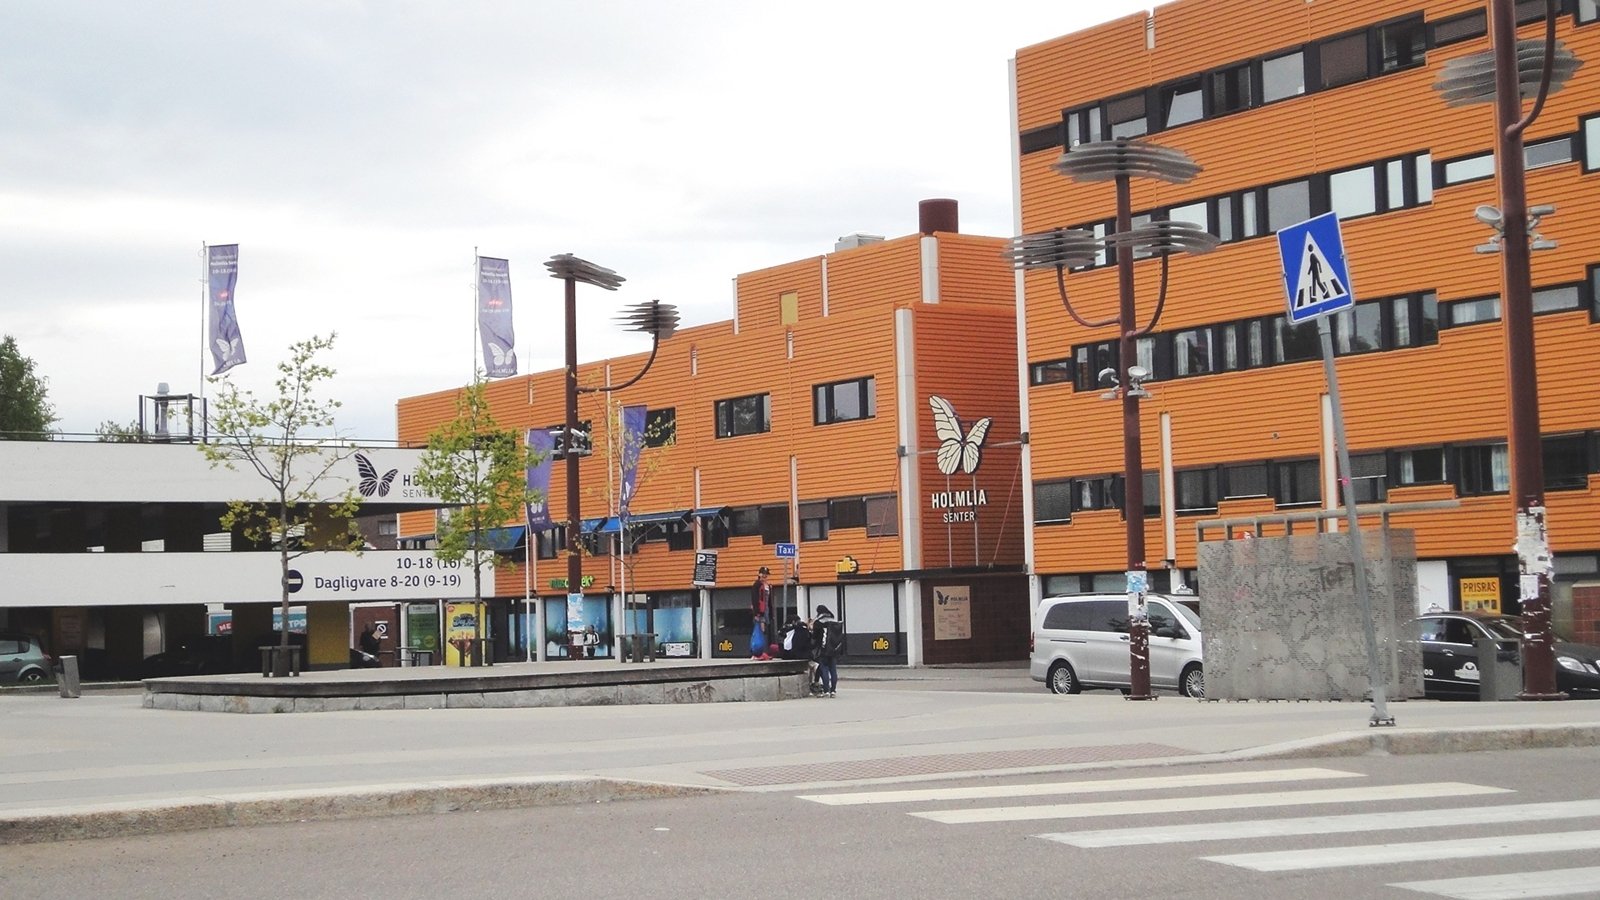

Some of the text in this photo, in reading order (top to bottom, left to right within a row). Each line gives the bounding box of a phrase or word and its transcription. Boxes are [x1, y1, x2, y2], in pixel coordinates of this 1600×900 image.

[931, 489, 987, 509] HOLMLIA
[943, 511, 975, 523] SENTER
[778, 545, 794, 554] Taxi
[396, 557, 433, 570] 10-18
[314, 574, 461, 592] Dagligvare 8-20 (9-19)
[1463, 581, 1497, 593] PRISRAS
